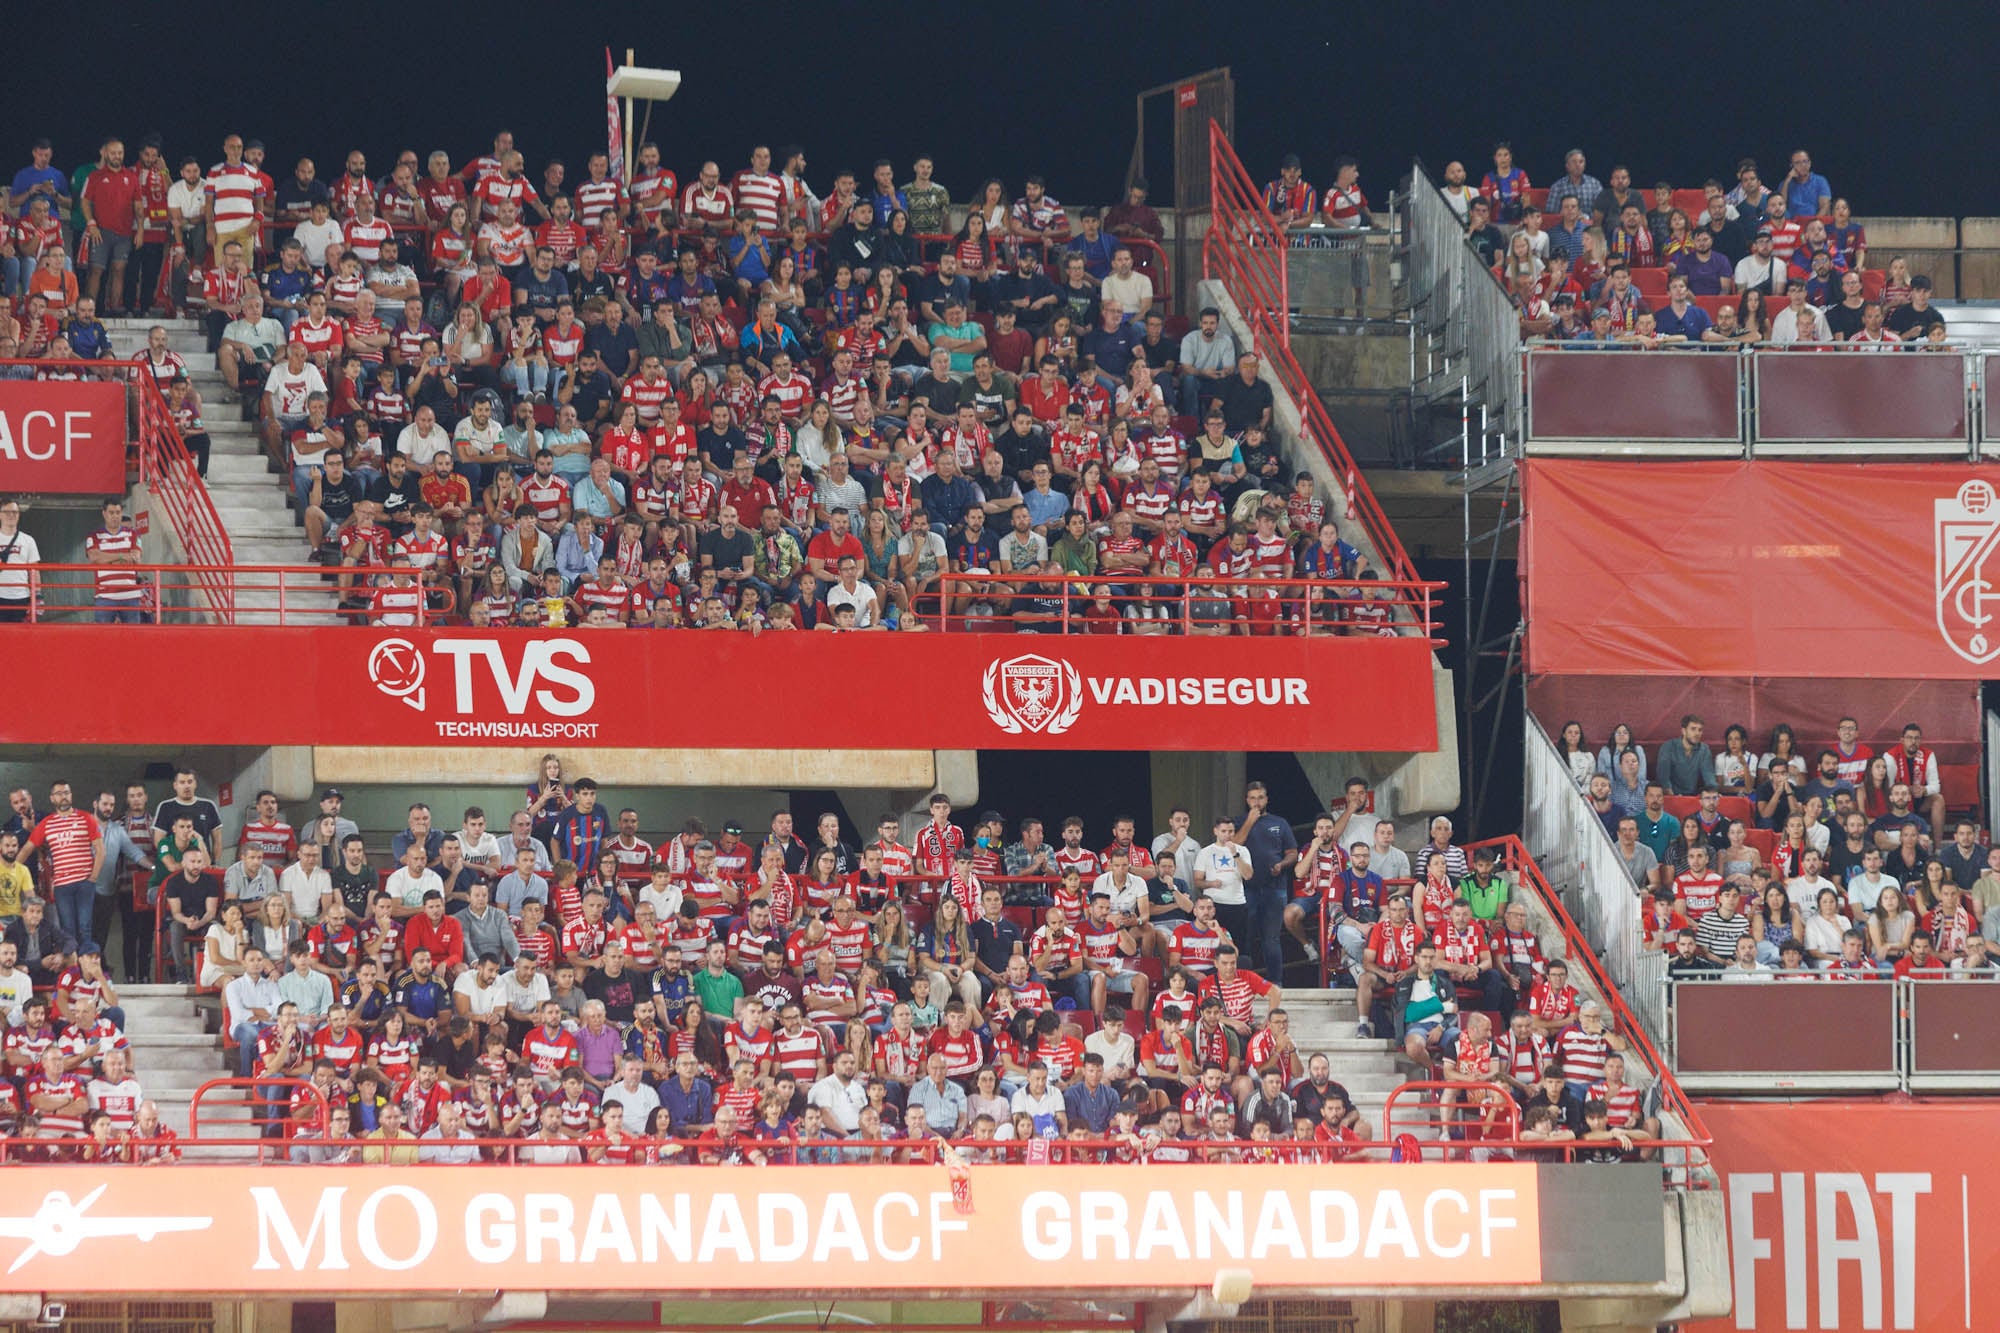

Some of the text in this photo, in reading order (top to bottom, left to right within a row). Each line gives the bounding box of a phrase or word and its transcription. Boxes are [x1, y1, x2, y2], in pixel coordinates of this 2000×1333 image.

[1034, 596, 1064, 605] HILFIG
[432, 638, 596, 717] TVS
[1007, 667, 1056, 676] VADISEGUR
[1087, 677, 1311, 706] VADISEGUR
[435, 721, 599, 738] TECHVISUALSPORT
[249, 1185, 438, 1271] MO
[1021, 1188, 1517, 1261] GRANADACF
[1728, 1172, 1933, 1330] FIAT
